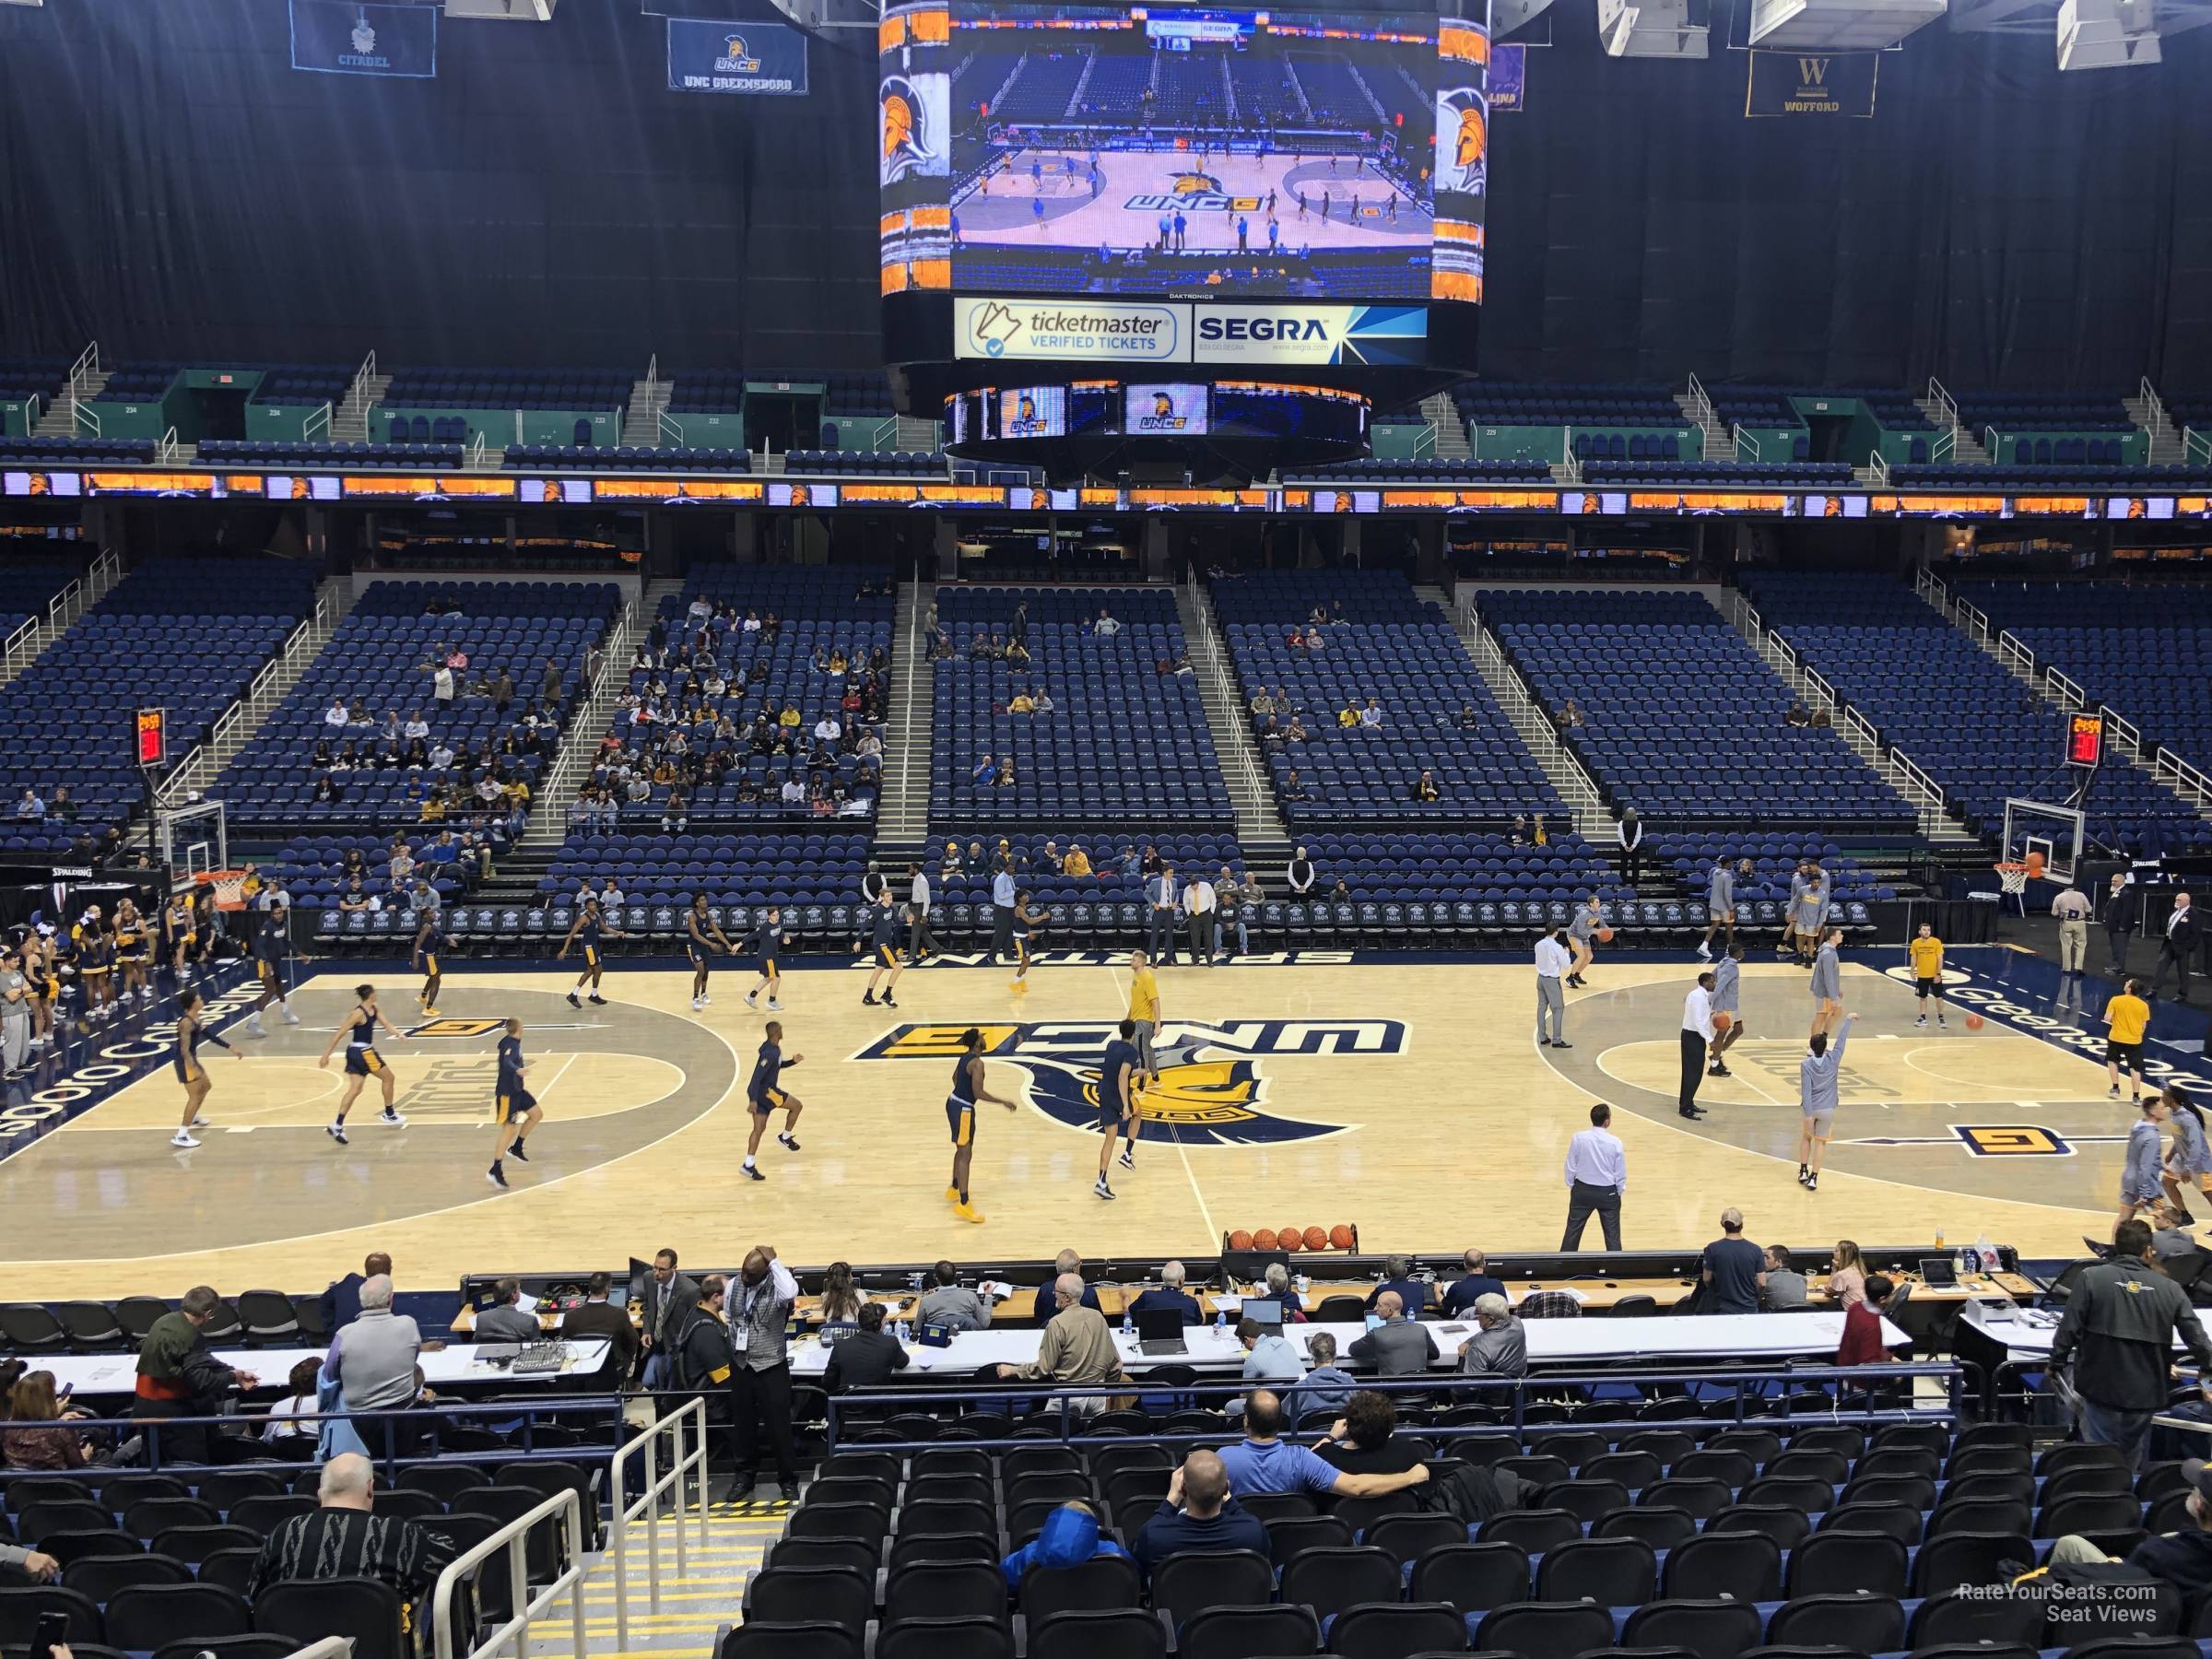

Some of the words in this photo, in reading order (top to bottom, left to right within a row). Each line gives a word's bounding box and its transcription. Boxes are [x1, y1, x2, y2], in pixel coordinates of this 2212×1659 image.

[338, 54, 391, 67] CITADEL
[715, 57, 760, 73] UNCG
[1799, 58, 1830, 85] W
[685, 76, 710, 88] UNC
[713, 76, 792, 90] GREENSBORO
[1488, 93, 1516, 104] LINA
[1784, 101, 1840, 112] WOFFORD
[1124, 194, 1265, 212] UNCG
[1031, 312, 1162, 334] ticketmaster
[1199, 317, 1328, 341] SEGRA
[1030, 335, 1095, 348] VERIFIED
[1098, 336, 1156, 350] TICKETS
[2074, 717, 2100, 734] 24:59
[2132, 859, 2160, 867] SPALDING
[53, 867, 92, 877] SPALDING
[0, 1065, 131, 1137] sboro
